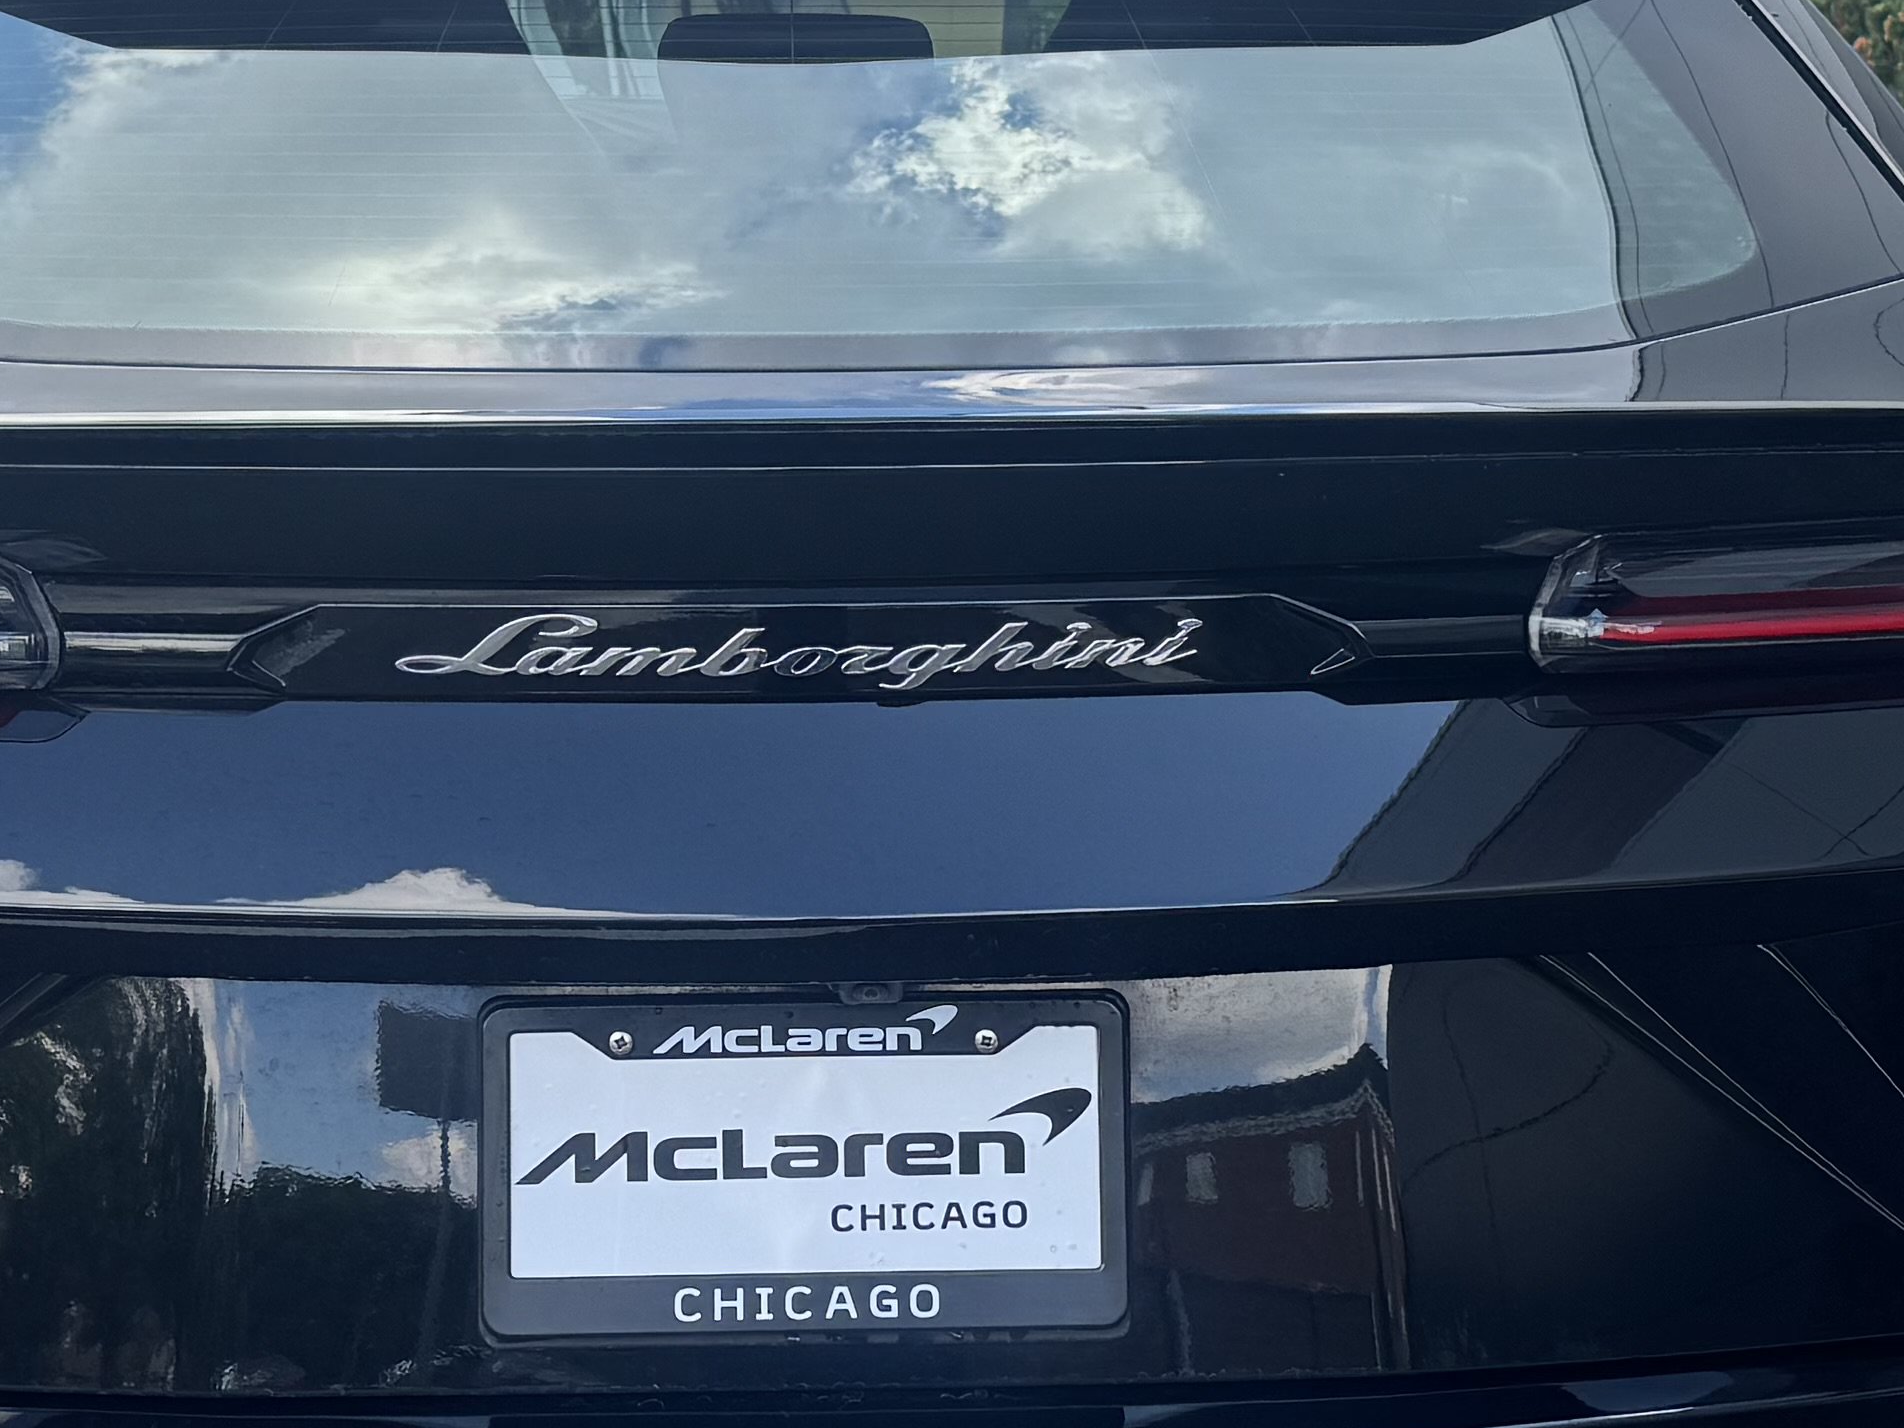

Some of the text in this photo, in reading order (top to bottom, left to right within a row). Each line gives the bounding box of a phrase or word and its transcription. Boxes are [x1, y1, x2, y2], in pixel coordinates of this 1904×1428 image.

[394, 613, 1202, 689] Lamborghini
[653, 1025, 923, 1054] McLaren
[514, 1128, 1027, 1185] McLaren
[830, 1199, 1029, 1233] CHICAGO
[673, 1283, 942, 1323] CHICAGO
